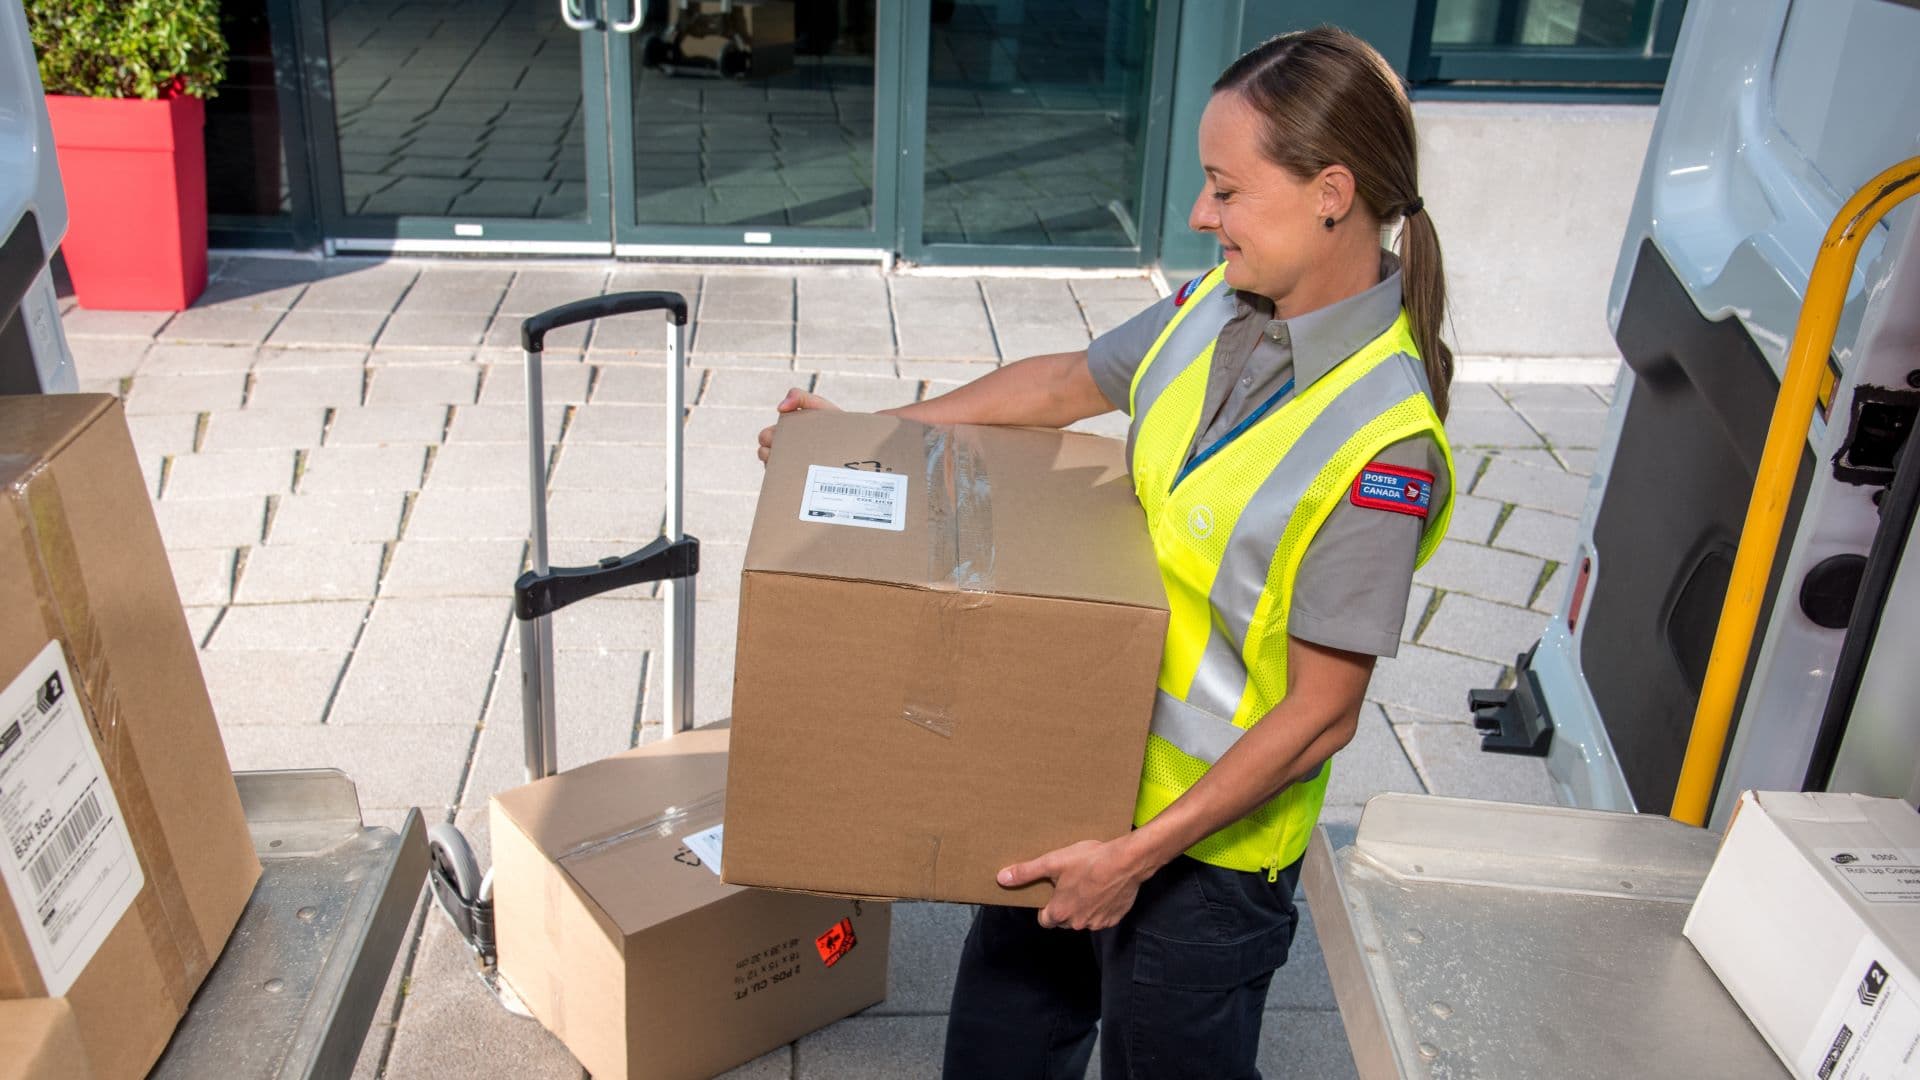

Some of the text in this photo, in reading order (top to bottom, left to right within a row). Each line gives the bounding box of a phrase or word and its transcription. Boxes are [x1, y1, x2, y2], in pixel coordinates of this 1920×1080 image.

[1364, 473, 1398, 485] POSTES
[1363, 486, 1401, 499] CANADA
[49, 678, 61, 697] 2
[34, 808, 54, 836] 3G2
[1871, 969, 1885, 985] 2
